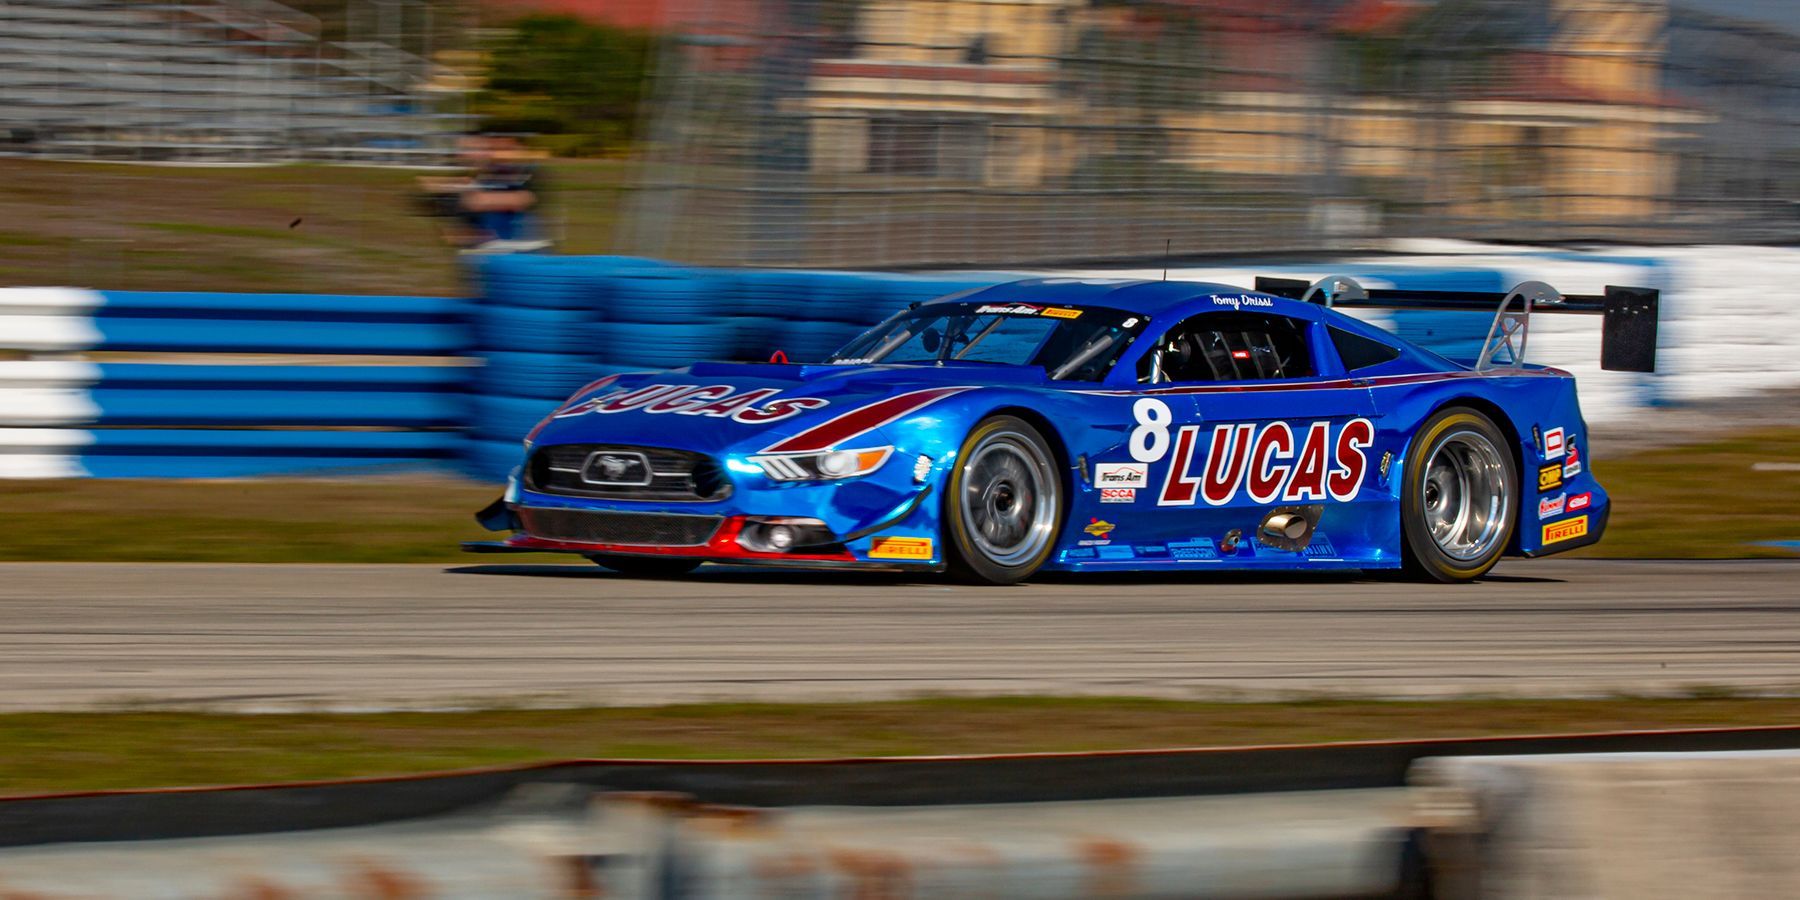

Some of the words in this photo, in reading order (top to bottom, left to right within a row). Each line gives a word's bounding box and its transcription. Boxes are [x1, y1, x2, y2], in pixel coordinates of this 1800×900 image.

[1210, 294, 1240, 310] Tomy
[1241, 294, 1273, 306] Drissi
[1122, 317, 1139, 328] 8
[552, 384, 830, 424] LUCAS
[1129, 397, 1172, 463] 8
[1157, 417, 1374, 506] LUCAS
[1101, 472, 1125, 482] Trans
[1125, 472, 1142, 482] Am
[1102, 489, 1135, 498] SCCA
[1545, 518, 1585, 541] PIRELLI
[871, 538, 929, 555] PIRELLI
